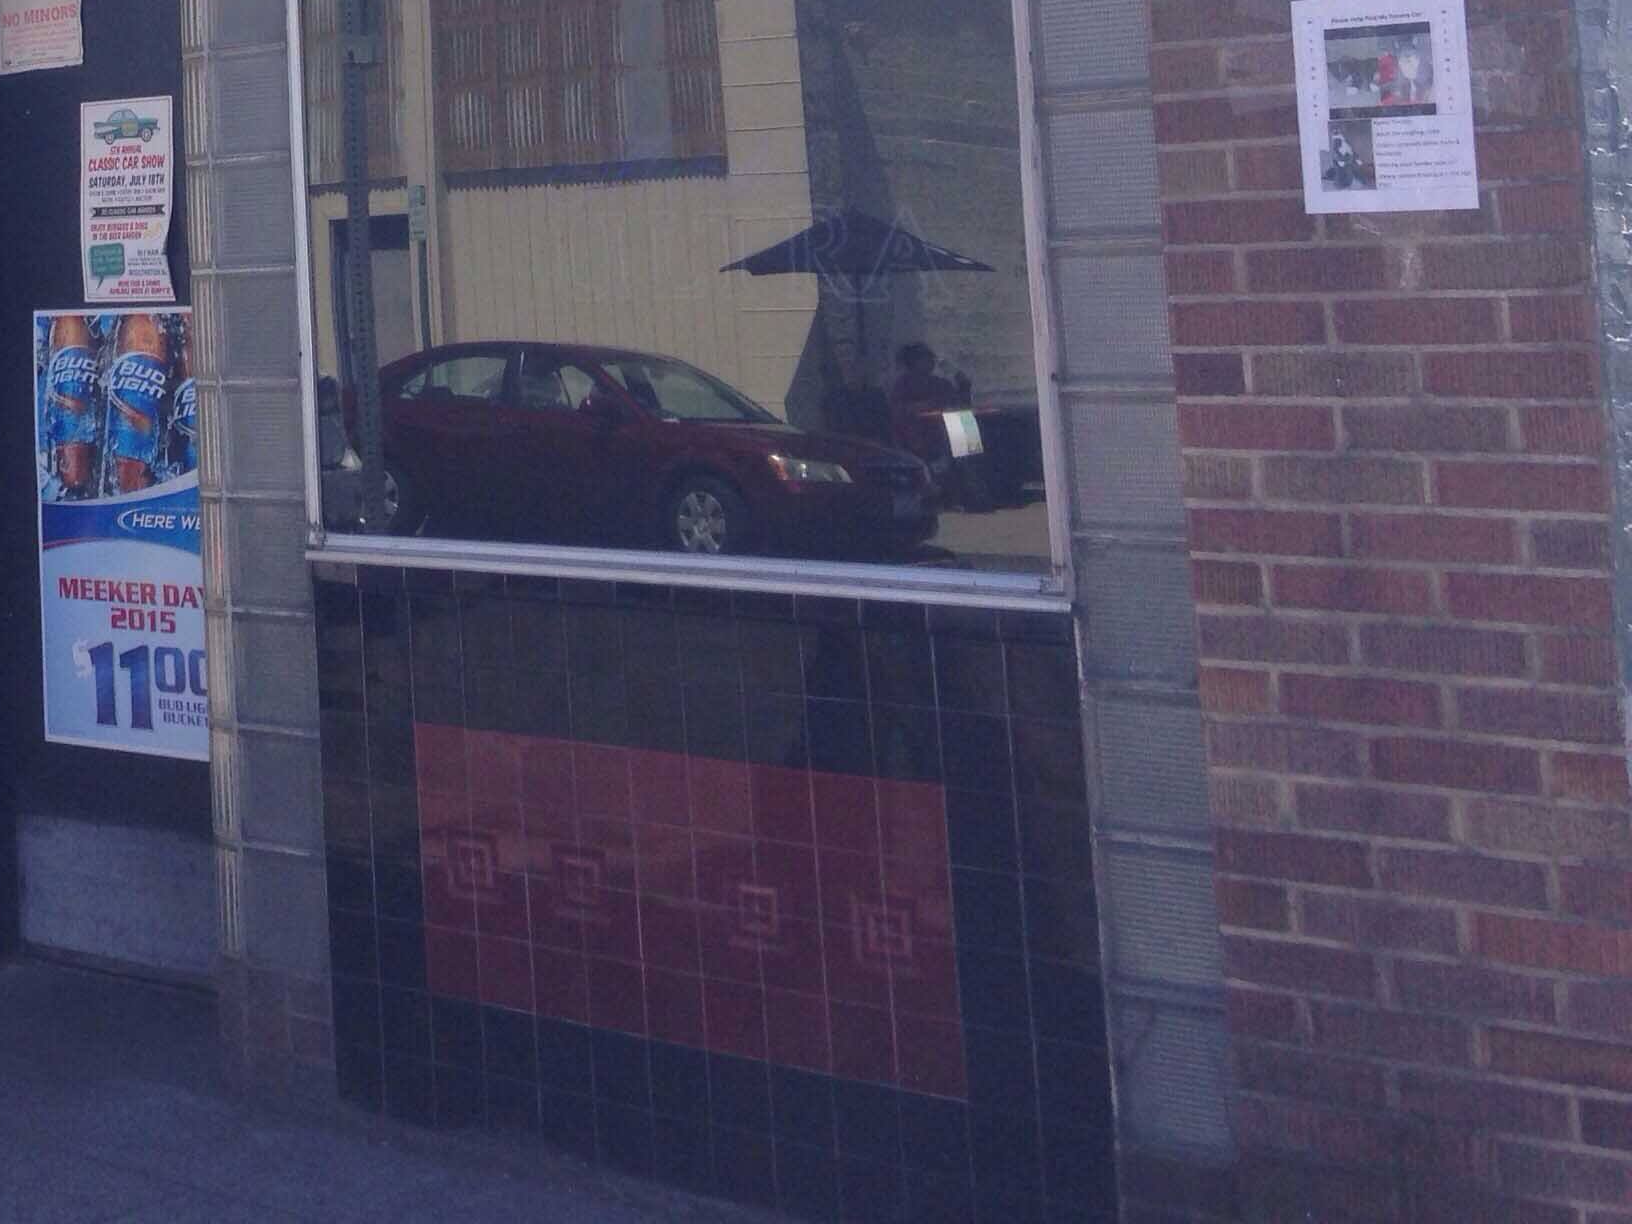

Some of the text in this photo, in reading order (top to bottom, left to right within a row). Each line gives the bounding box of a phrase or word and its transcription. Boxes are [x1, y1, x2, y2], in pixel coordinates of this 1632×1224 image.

[2, 3, 77, 27] NO MINORS
[88, 154, 166, 172] CLASSIC CAR SHOW
[88, 175, 127, 188] SATURDAY,
[129, 175, 146, 186] JULY
[55, 358, 97, 372] BUD
[119, 360, 166, 384] BUD
[111, 377, 166, 399] LIGHT
[132, 513, 176, 529] HERE
[59, 577, 157, 605] MEEKER
[111, 606, 176, 633] 2015
[158, 698, 208, 714] BUD LIG
